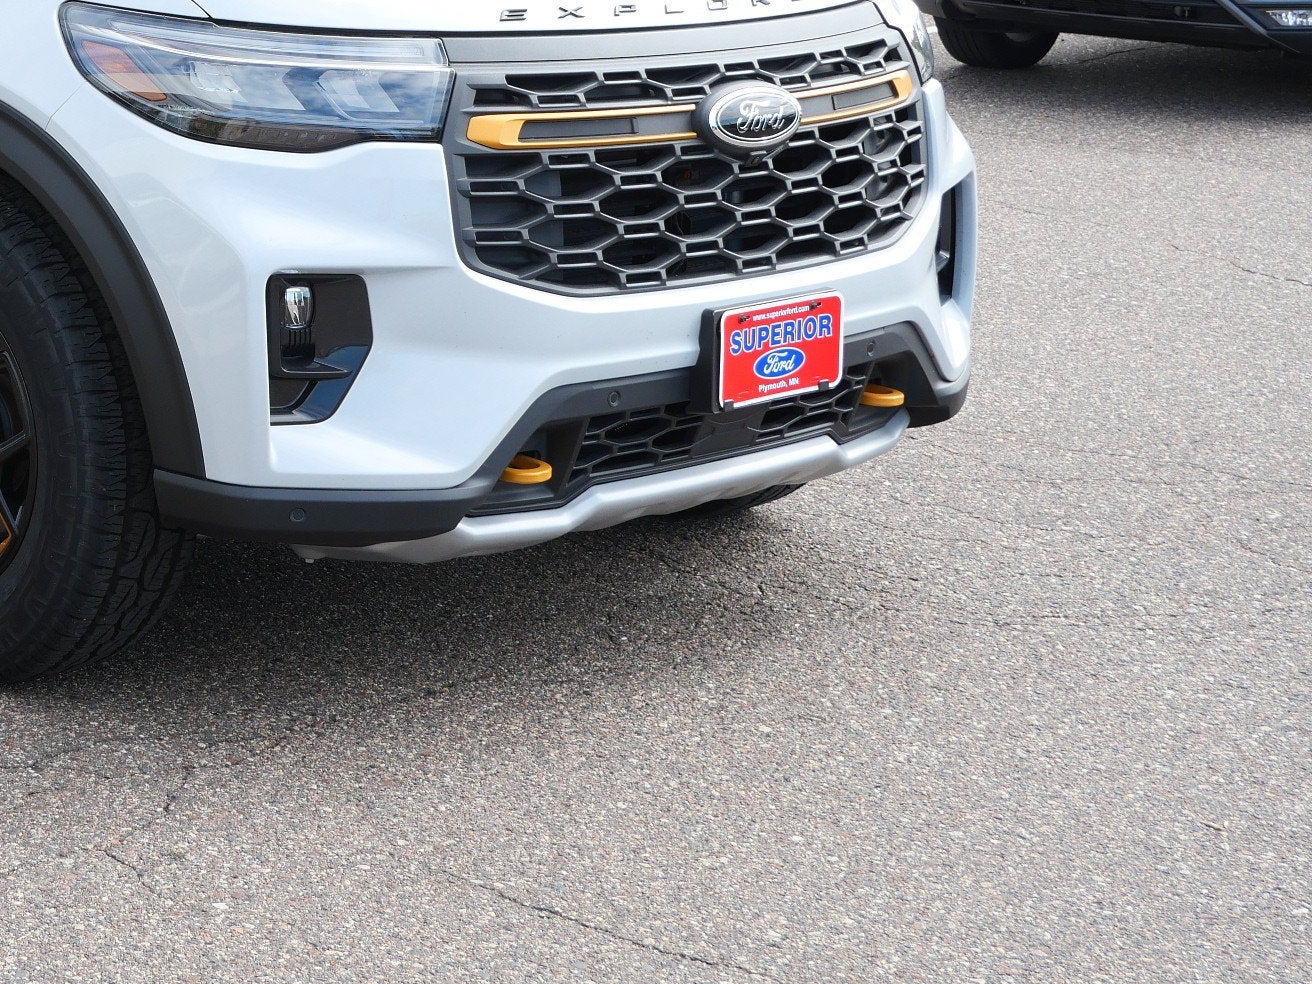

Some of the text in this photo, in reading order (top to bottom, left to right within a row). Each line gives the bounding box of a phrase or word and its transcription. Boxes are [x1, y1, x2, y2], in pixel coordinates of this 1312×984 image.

[737, 100, 785, 134] Ford
[752, 305, 810, 322] www.superiorford.com
[729, 313, 833, 356] SUPERIOR
[763, 351, 795, 375] Ford
[758, 379, 788, 393] Plymouth,
